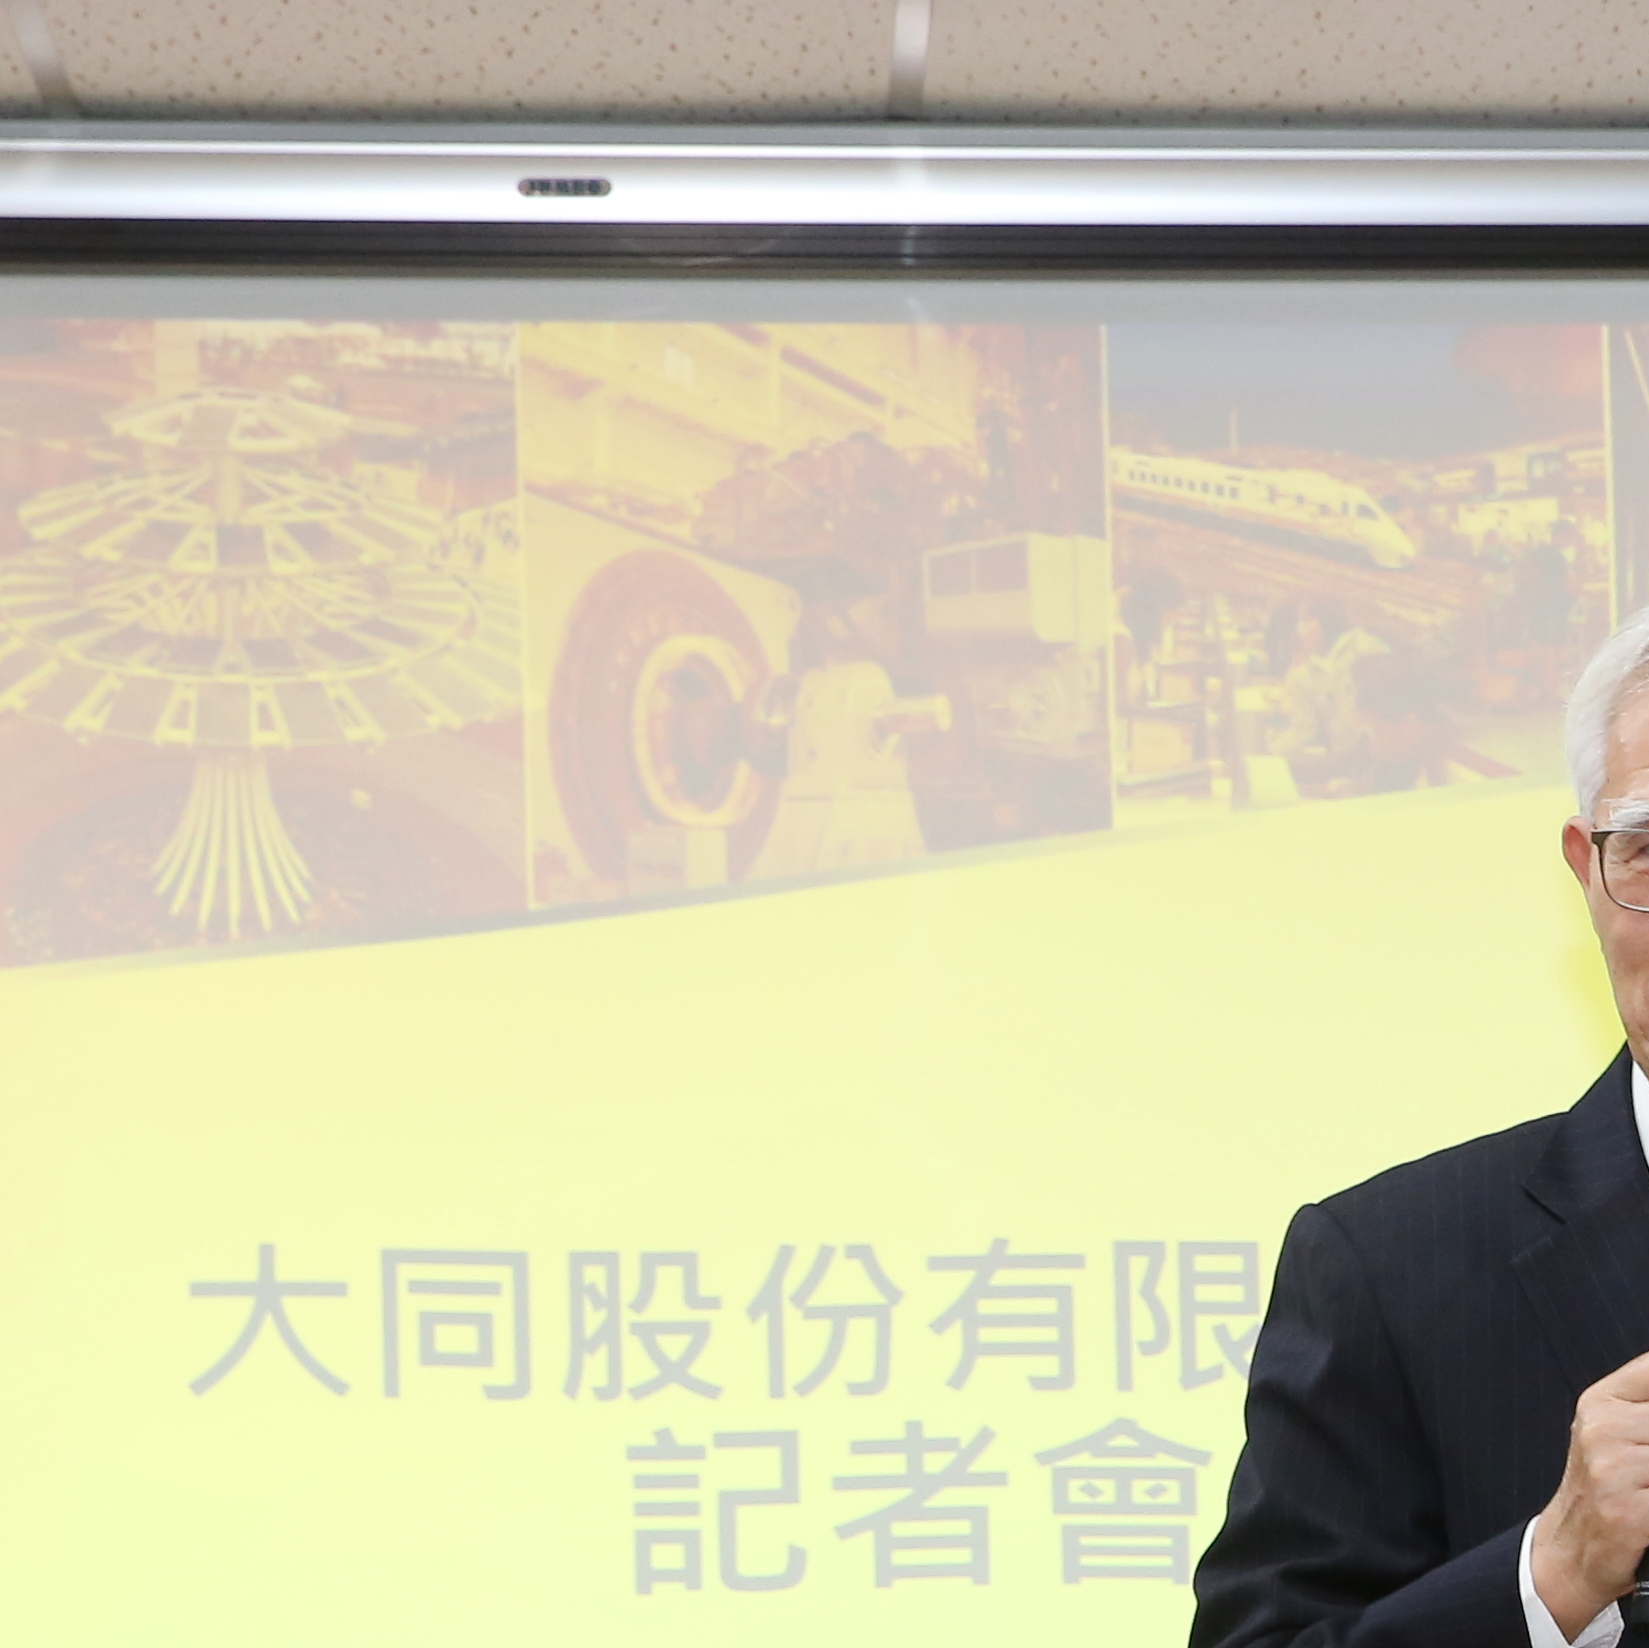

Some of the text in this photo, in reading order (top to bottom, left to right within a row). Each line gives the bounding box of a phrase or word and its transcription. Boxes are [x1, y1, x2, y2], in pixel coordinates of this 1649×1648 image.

[189, 1236, 1258, 1402] 大同股份有限
[625, 1415, 1213, 1596] 記者會
